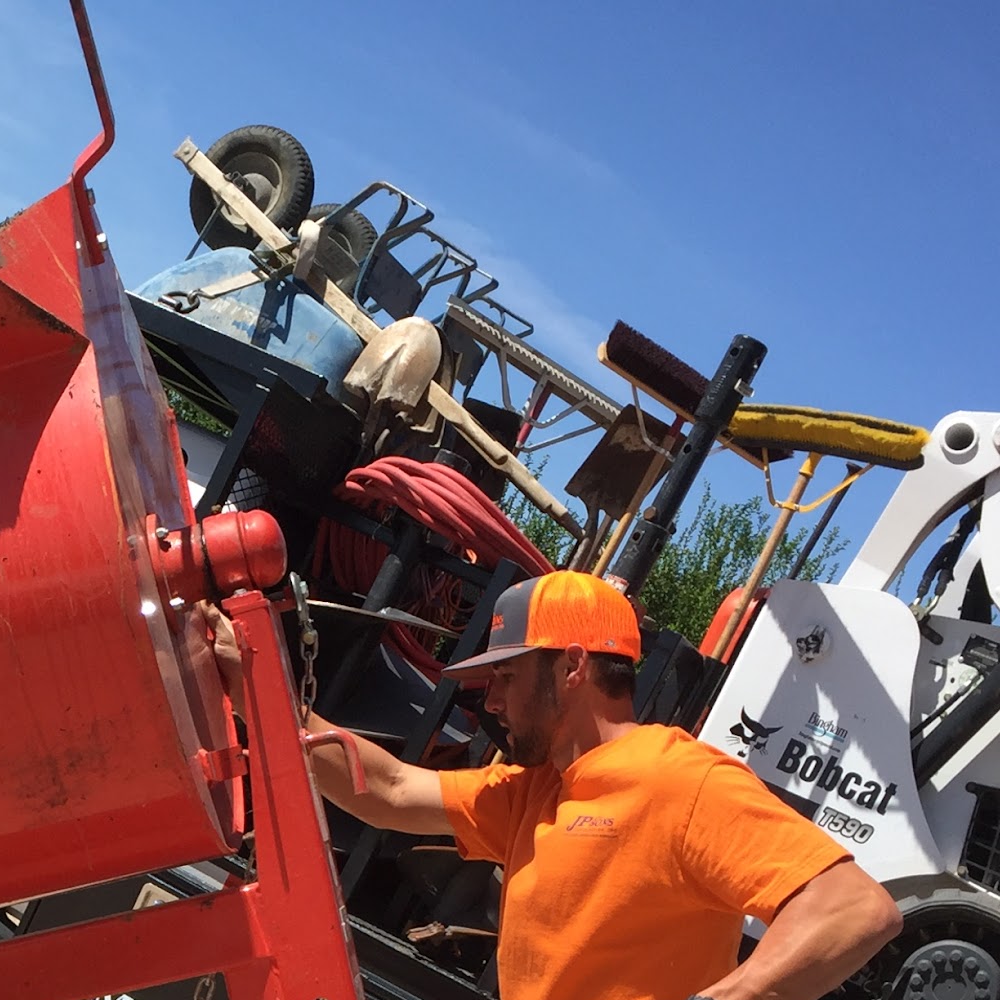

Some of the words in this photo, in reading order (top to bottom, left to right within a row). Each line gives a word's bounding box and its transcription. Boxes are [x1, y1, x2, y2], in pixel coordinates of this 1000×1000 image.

[807, 711, 848, 738] Bingham
[776, 737, 897, 816] Bobcat
[817, 806, 875, 844] T590
